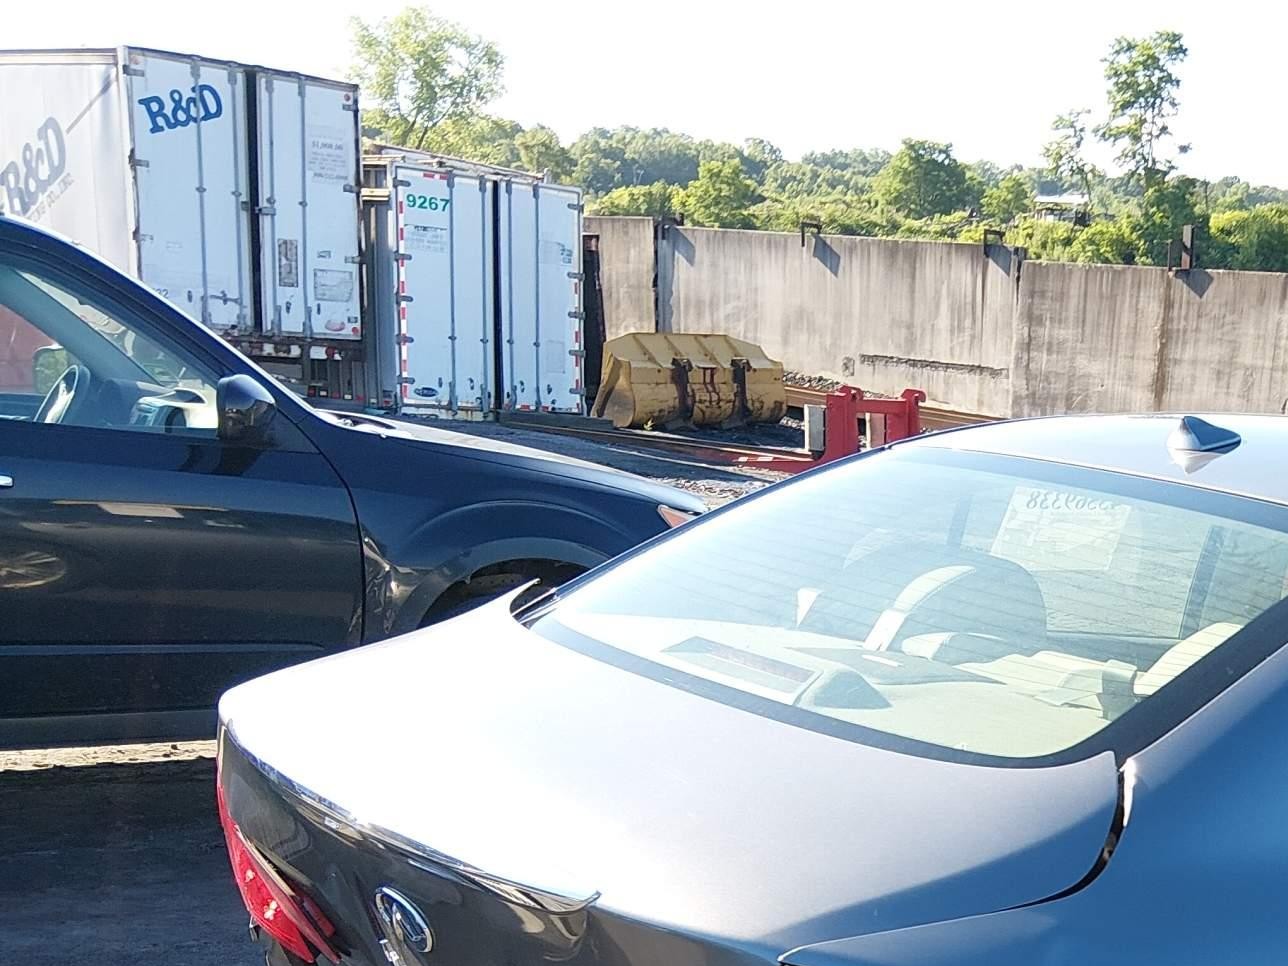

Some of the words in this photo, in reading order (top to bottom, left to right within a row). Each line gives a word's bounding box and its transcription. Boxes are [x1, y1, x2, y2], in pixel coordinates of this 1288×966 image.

[137, 84, 223, 134] R&D
[0, 116, 65, 216] R&D
[406, 193, 450, 212] 9267
